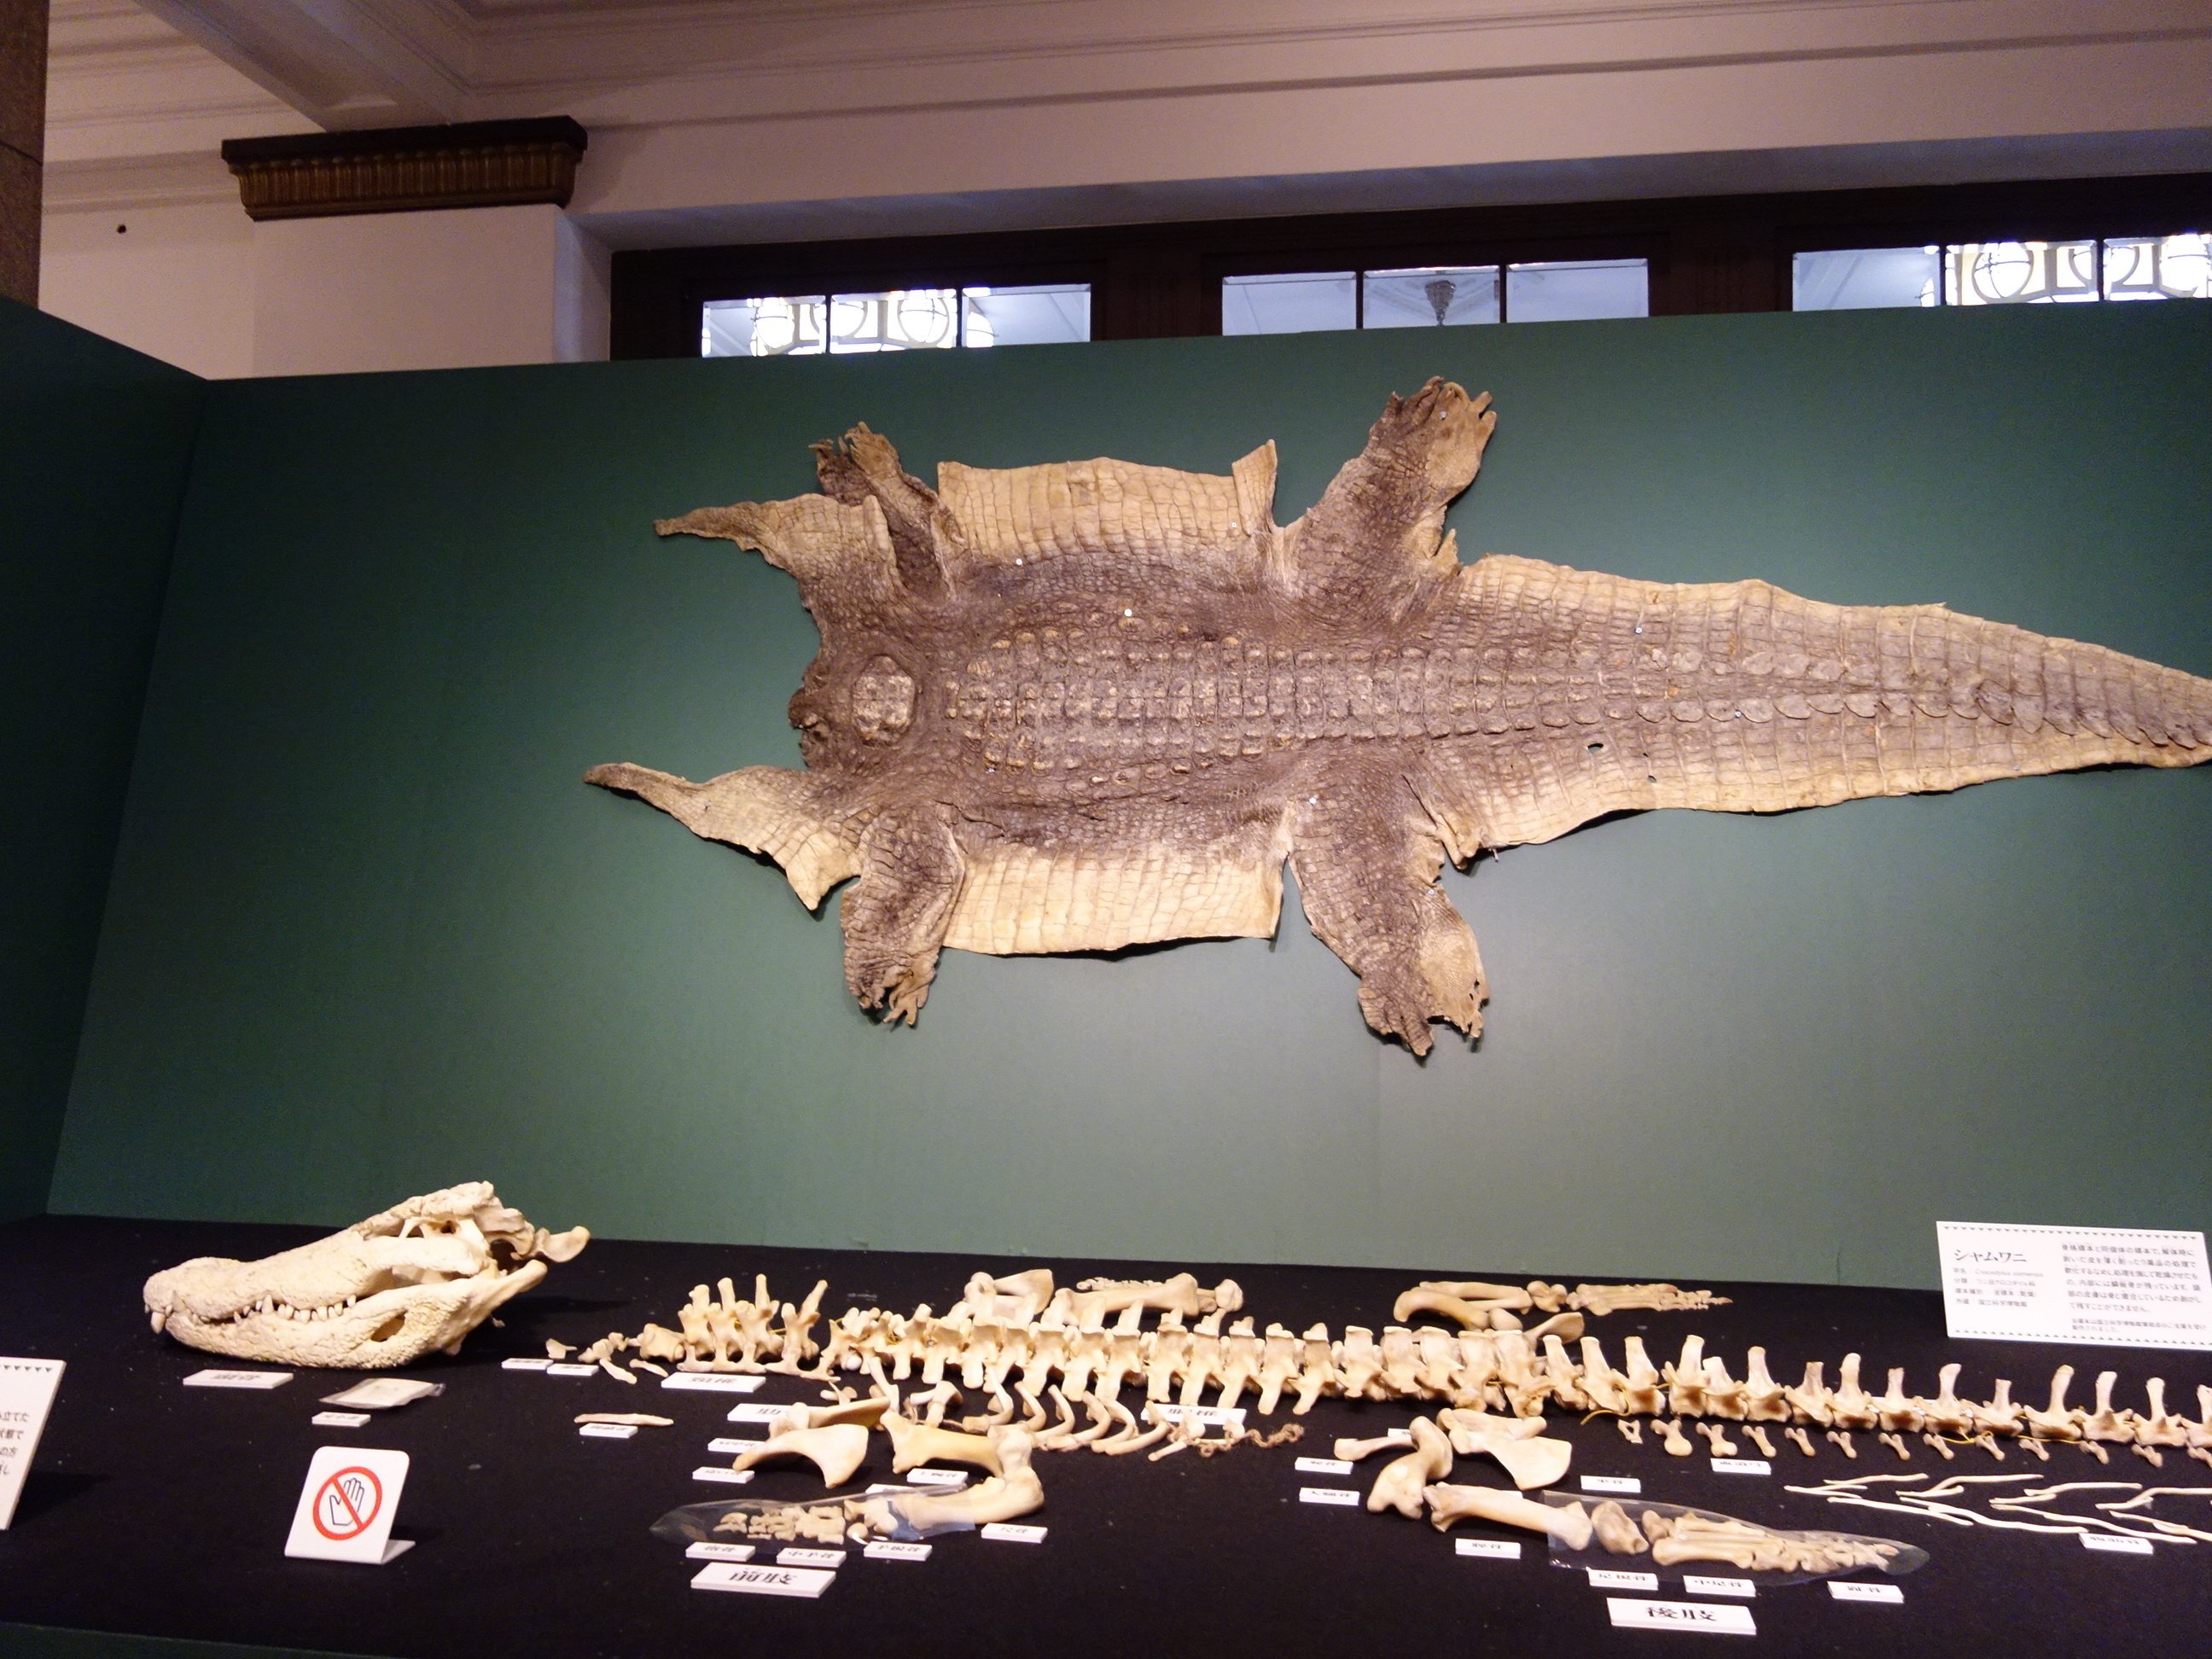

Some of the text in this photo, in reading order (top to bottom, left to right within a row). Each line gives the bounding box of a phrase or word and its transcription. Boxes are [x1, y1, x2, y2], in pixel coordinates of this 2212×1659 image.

[1953, 1249, 2028, 1263] シャムワニ
[1645, 1605, 1718, 1623] 後肢
